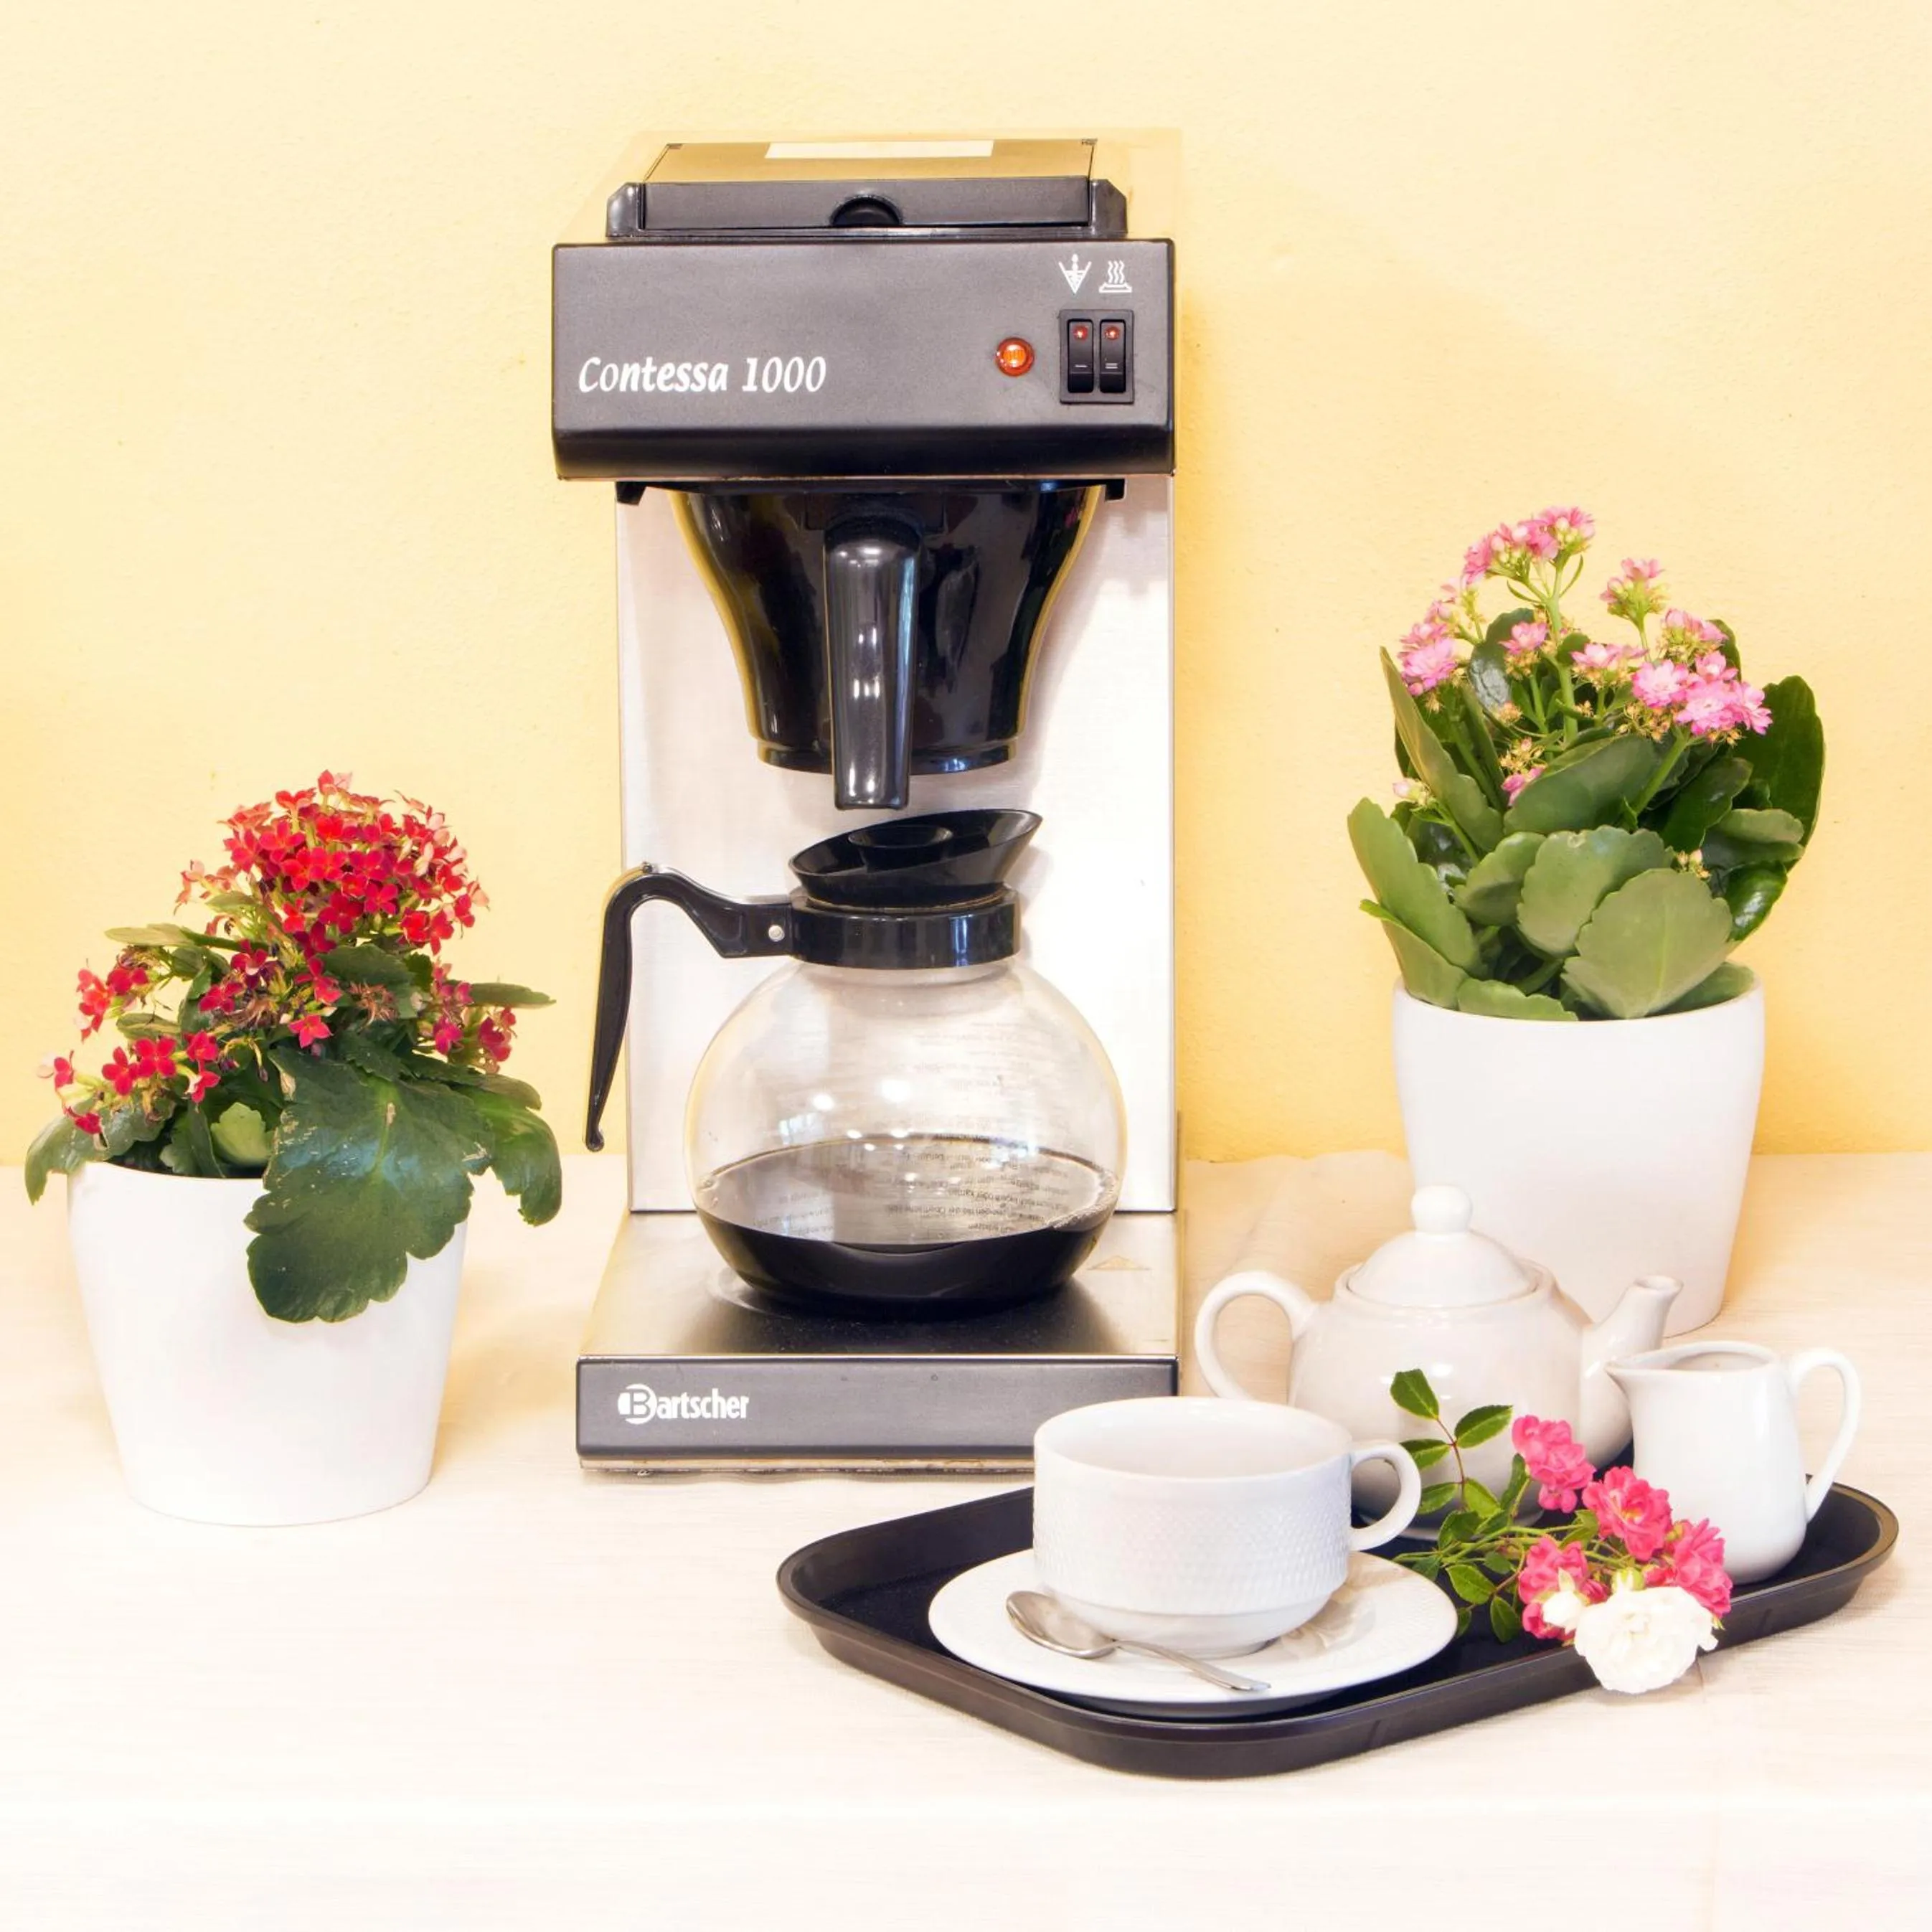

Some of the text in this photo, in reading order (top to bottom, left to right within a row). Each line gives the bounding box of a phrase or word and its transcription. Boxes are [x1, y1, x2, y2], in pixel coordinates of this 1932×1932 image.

[578, 356, 826, 393] Contessa 1000
[618, 1383, 750, 1425] Bartscher
